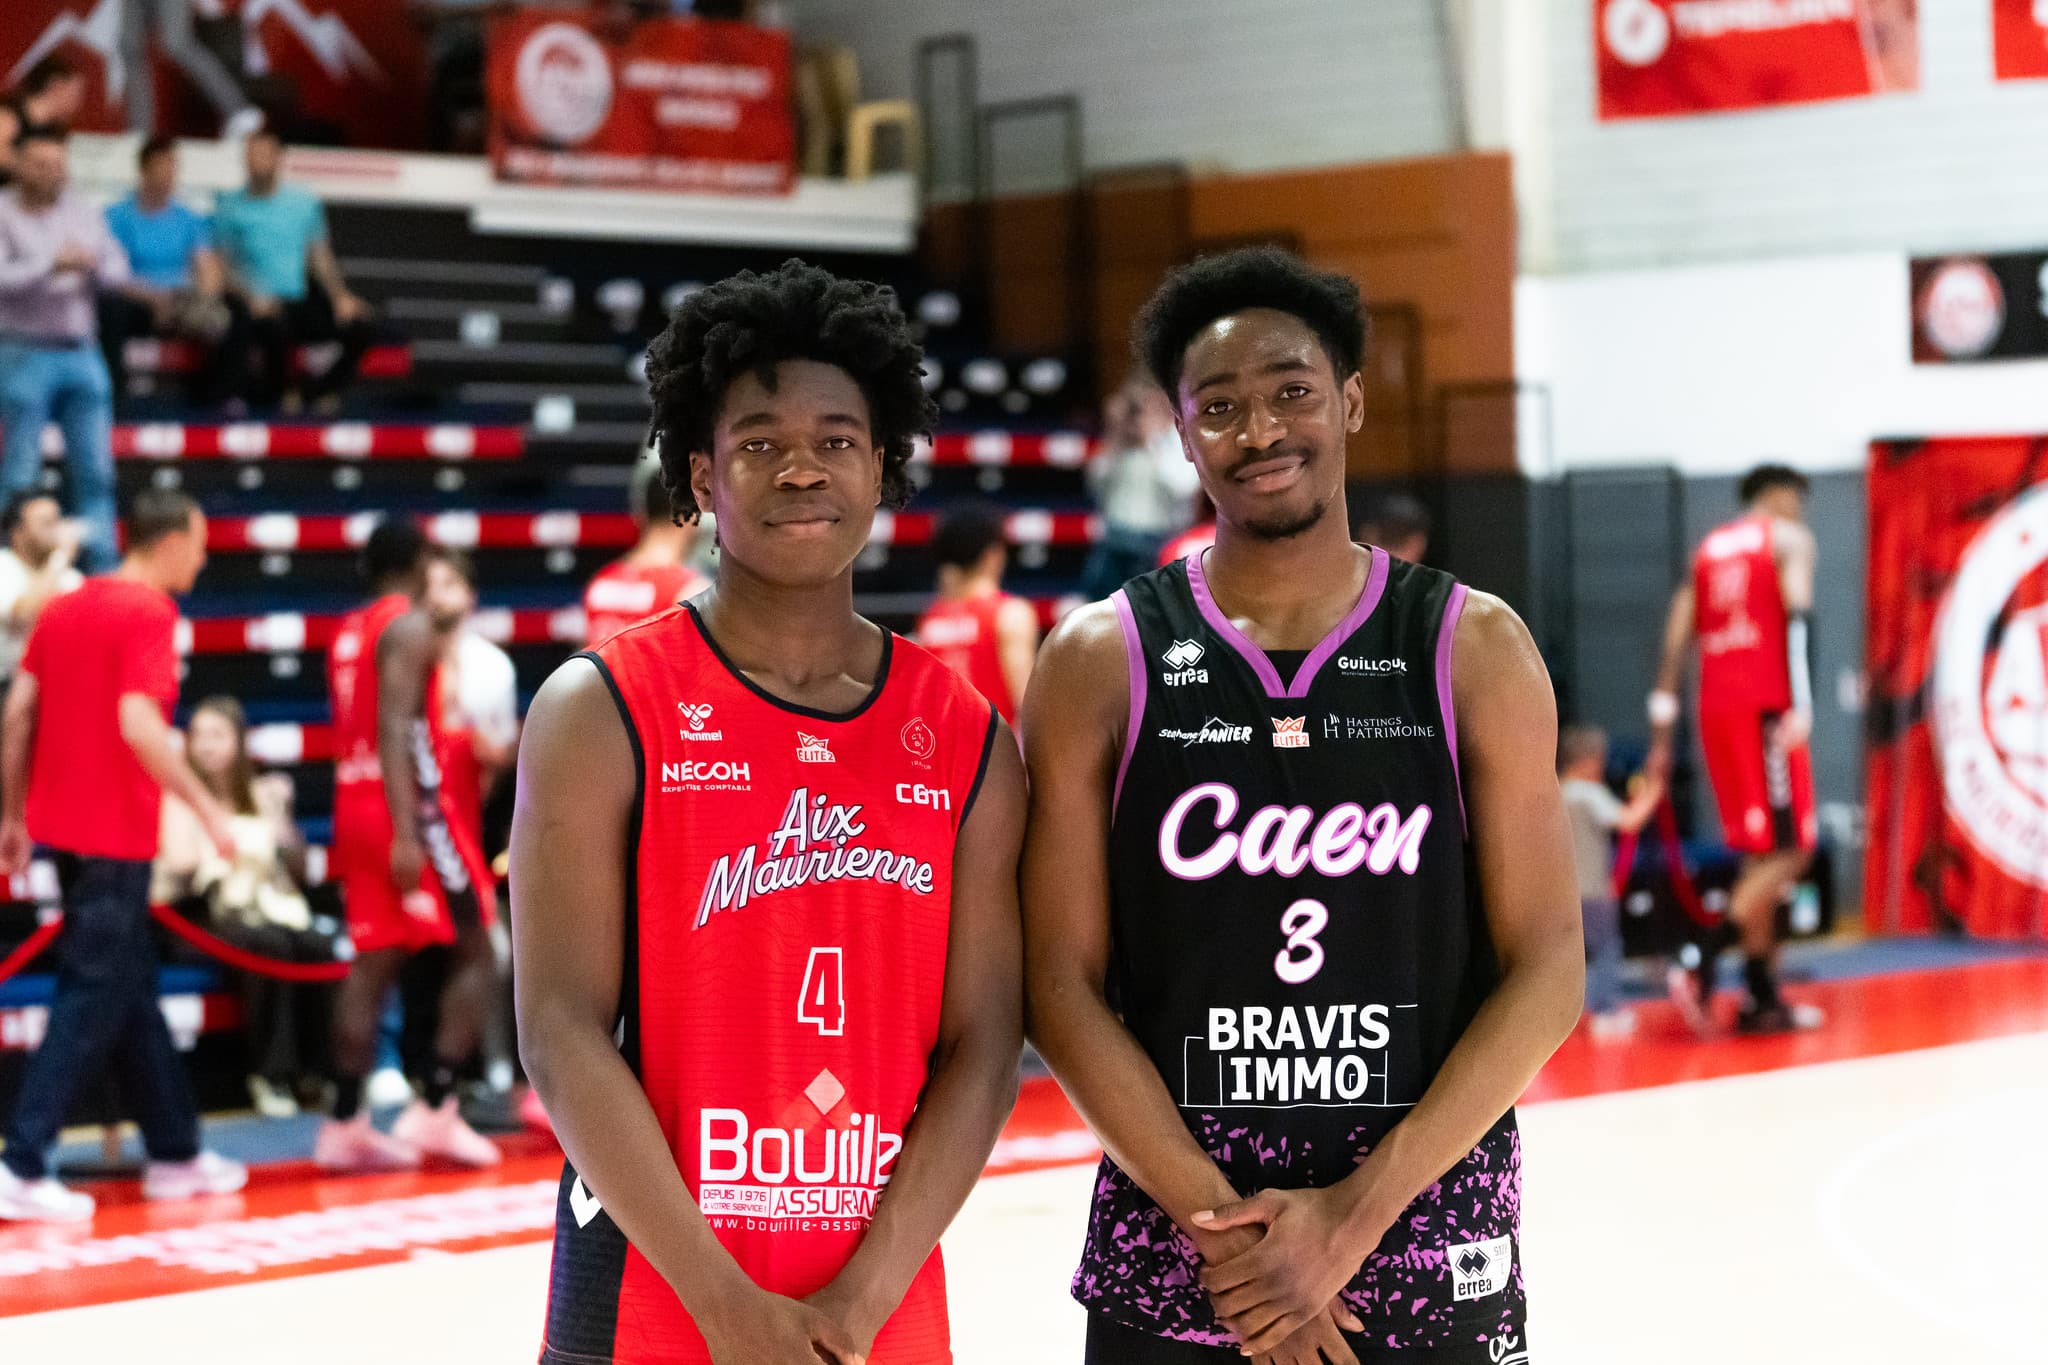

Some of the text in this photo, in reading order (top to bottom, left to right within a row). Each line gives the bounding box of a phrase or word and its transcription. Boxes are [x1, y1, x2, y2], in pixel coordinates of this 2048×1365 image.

[679, 729, 722, 741] hummel
[1198, 726, 1253, 744] PANIER
[1347, 725, 1435, 739] PATRIMOINE
[661, 783, 751, 793] EXPERTISE COMPTABLE
[766, 786, 866, 856] Aix
[1158, 782, 1433, 881] Caen
[691, 835, 935, 931] Maurienne
[1273, 898, 1330, 985] 3
[797, 946, 846, 1037] 4
[1208, 1004, 1391, 1051] BRAVIS
[1229, 1054, 1370, 1102] IMMO
[703, 1188, 767, 1202] DEPUIS 1976
[773, 1188, 882, 1217] ASSURAN
[1457, 1279, 1492, 1297] errea
